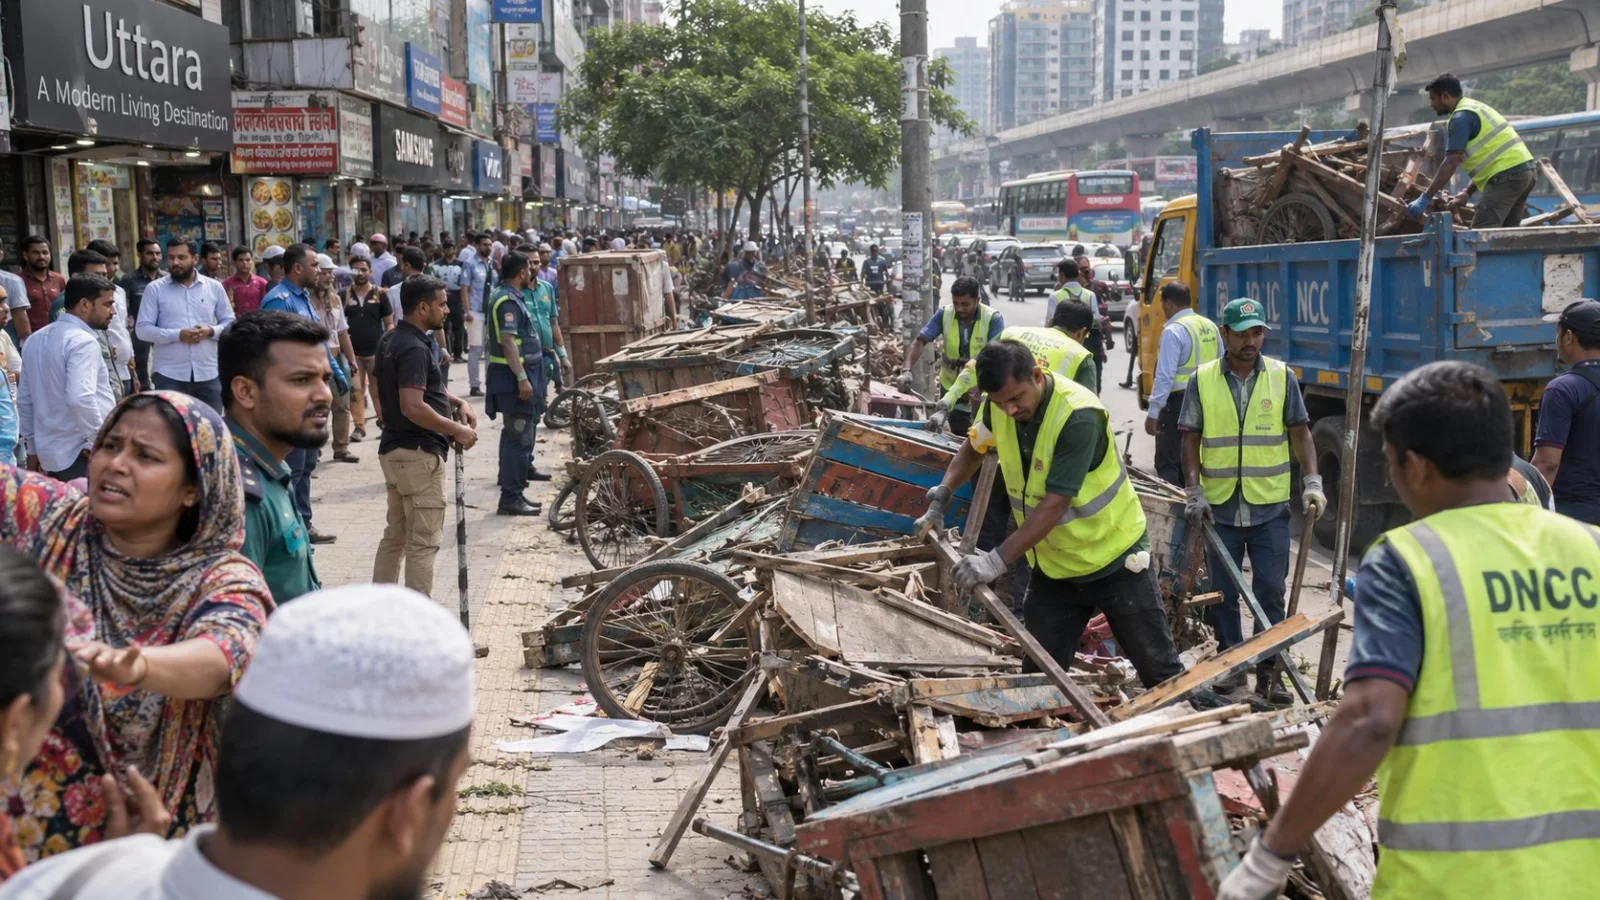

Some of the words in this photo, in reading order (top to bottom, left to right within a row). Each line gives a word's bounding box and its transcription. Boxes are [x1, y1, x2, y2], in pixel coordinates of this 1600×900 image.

[83, 4, 202, 91] Uttara
[37, 75, 50, 102] A
[55, 78, 116, 114] Modern
[121, 93, 160, 126] Living
[164, 101, 229, 131] Destination
[394, 128, 434, 168] SAMSUNG
[1296, 281, 1330, 325] NCC
[1481, 567, 1599, 613] DNCC
